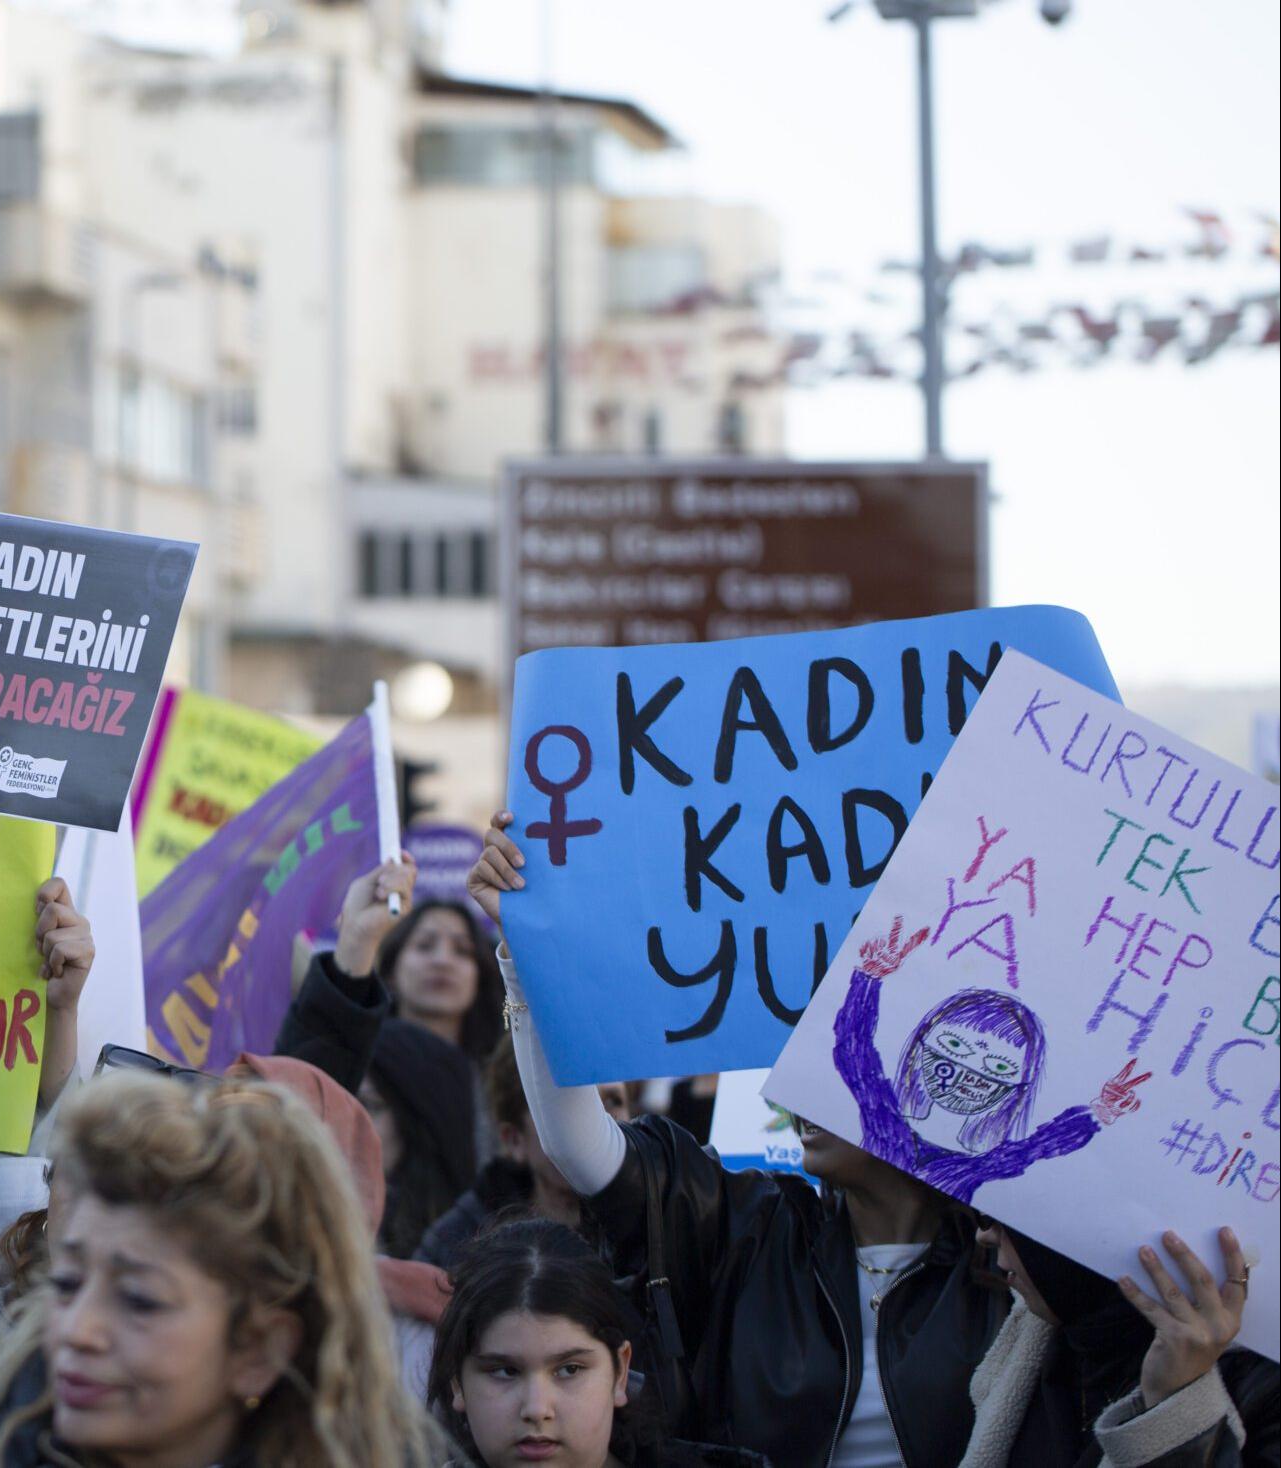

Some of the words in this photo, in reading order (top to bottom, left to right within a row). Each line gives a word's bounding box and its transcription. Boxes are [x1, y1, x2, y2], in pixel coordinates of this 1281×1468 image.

[6, 780, 46, 792] FEDERASYONU
[8, 769, 58, 785] FEMİNİSTLER
[12, 759, 34, 771] GENÇ
[617, 642, 1002, 796] KADIN
[684, 772, 933, 912] KAD
[963, 815, 1037, 918] YA
[1083, 896, 1213, 986] HEP
[1096, 808, 1213, 915] TEK
[648, 910, 861, 1044] YU
[930, 877, 1019, 990] YA
[1086, 968, 1280, 1130] HİÇ
